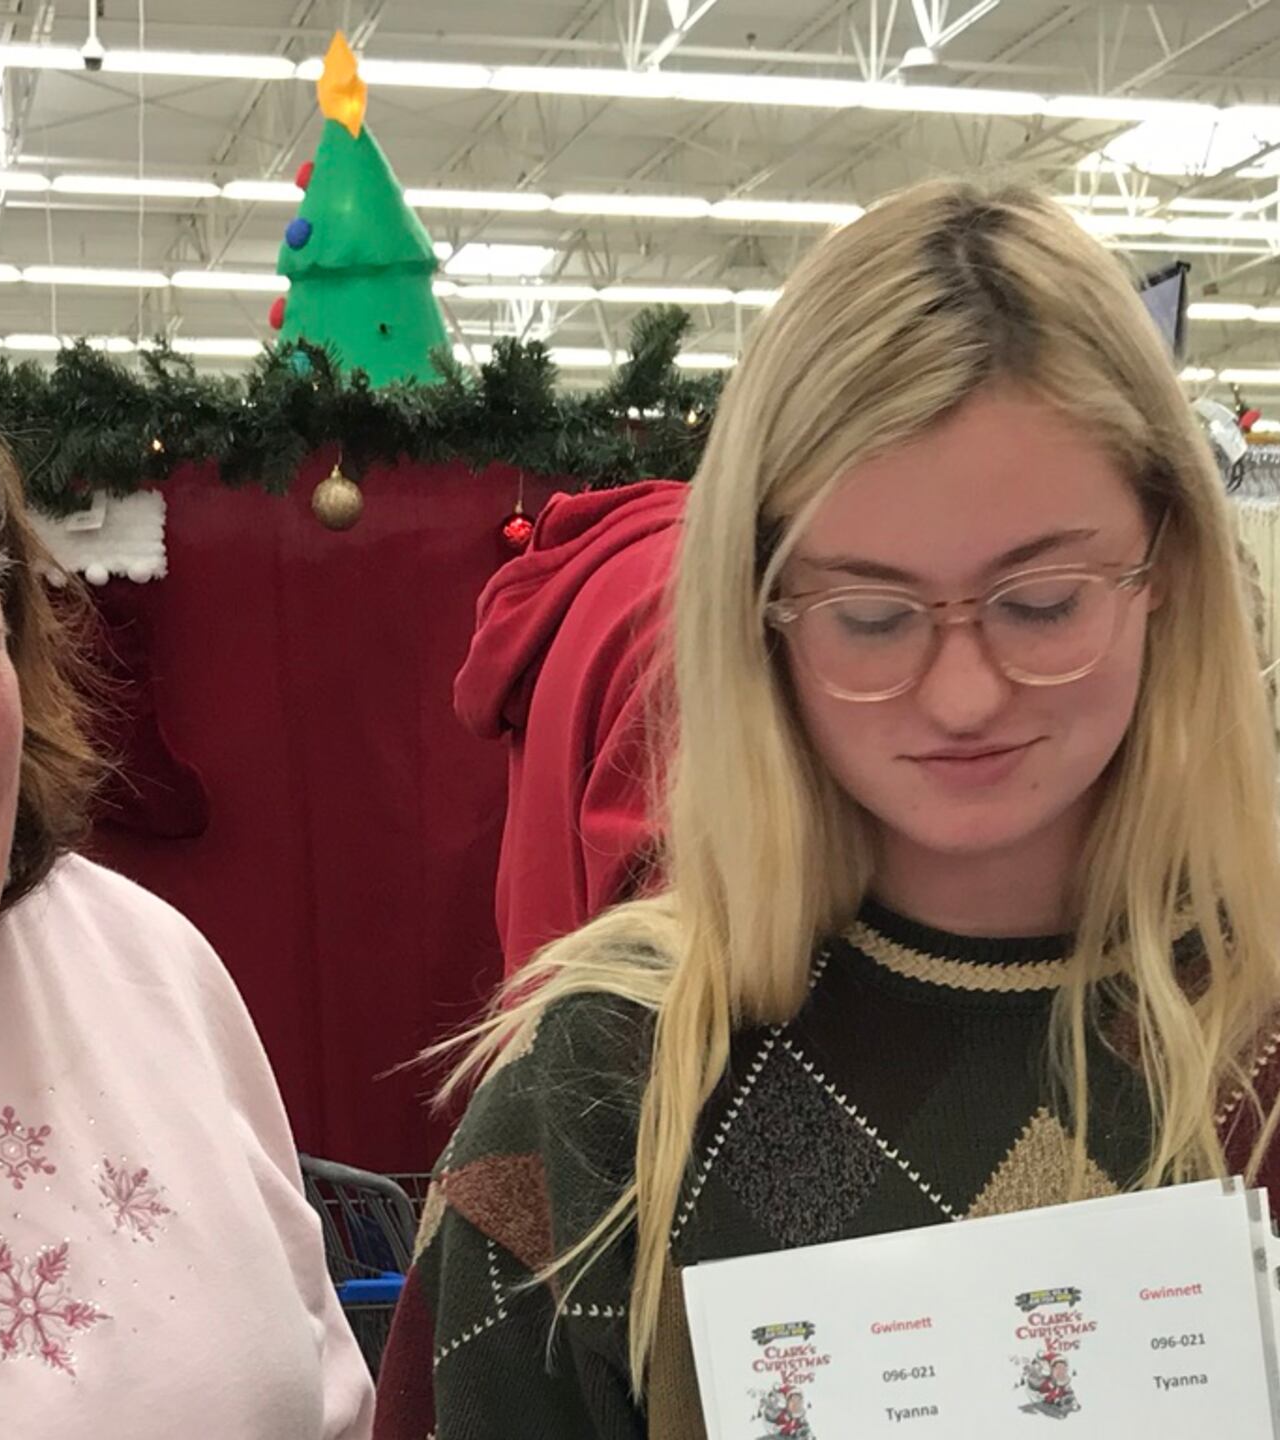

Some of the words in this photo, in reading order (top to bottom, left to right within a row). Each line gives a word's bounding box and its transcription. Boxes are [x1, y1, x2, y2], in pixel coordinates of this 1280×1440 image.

[1139, 1283, 1202, 1300] Gwinnett
[870, 1317, 932, 1334] Gwinnett
[1151, 1333, 1205, 1350] 096-021
[883, 1366, 936, 1382] 096-021
[1153, 1373, 1208, 1391] Tyanna
[885, 1404, 938, 1422] Tyanna
